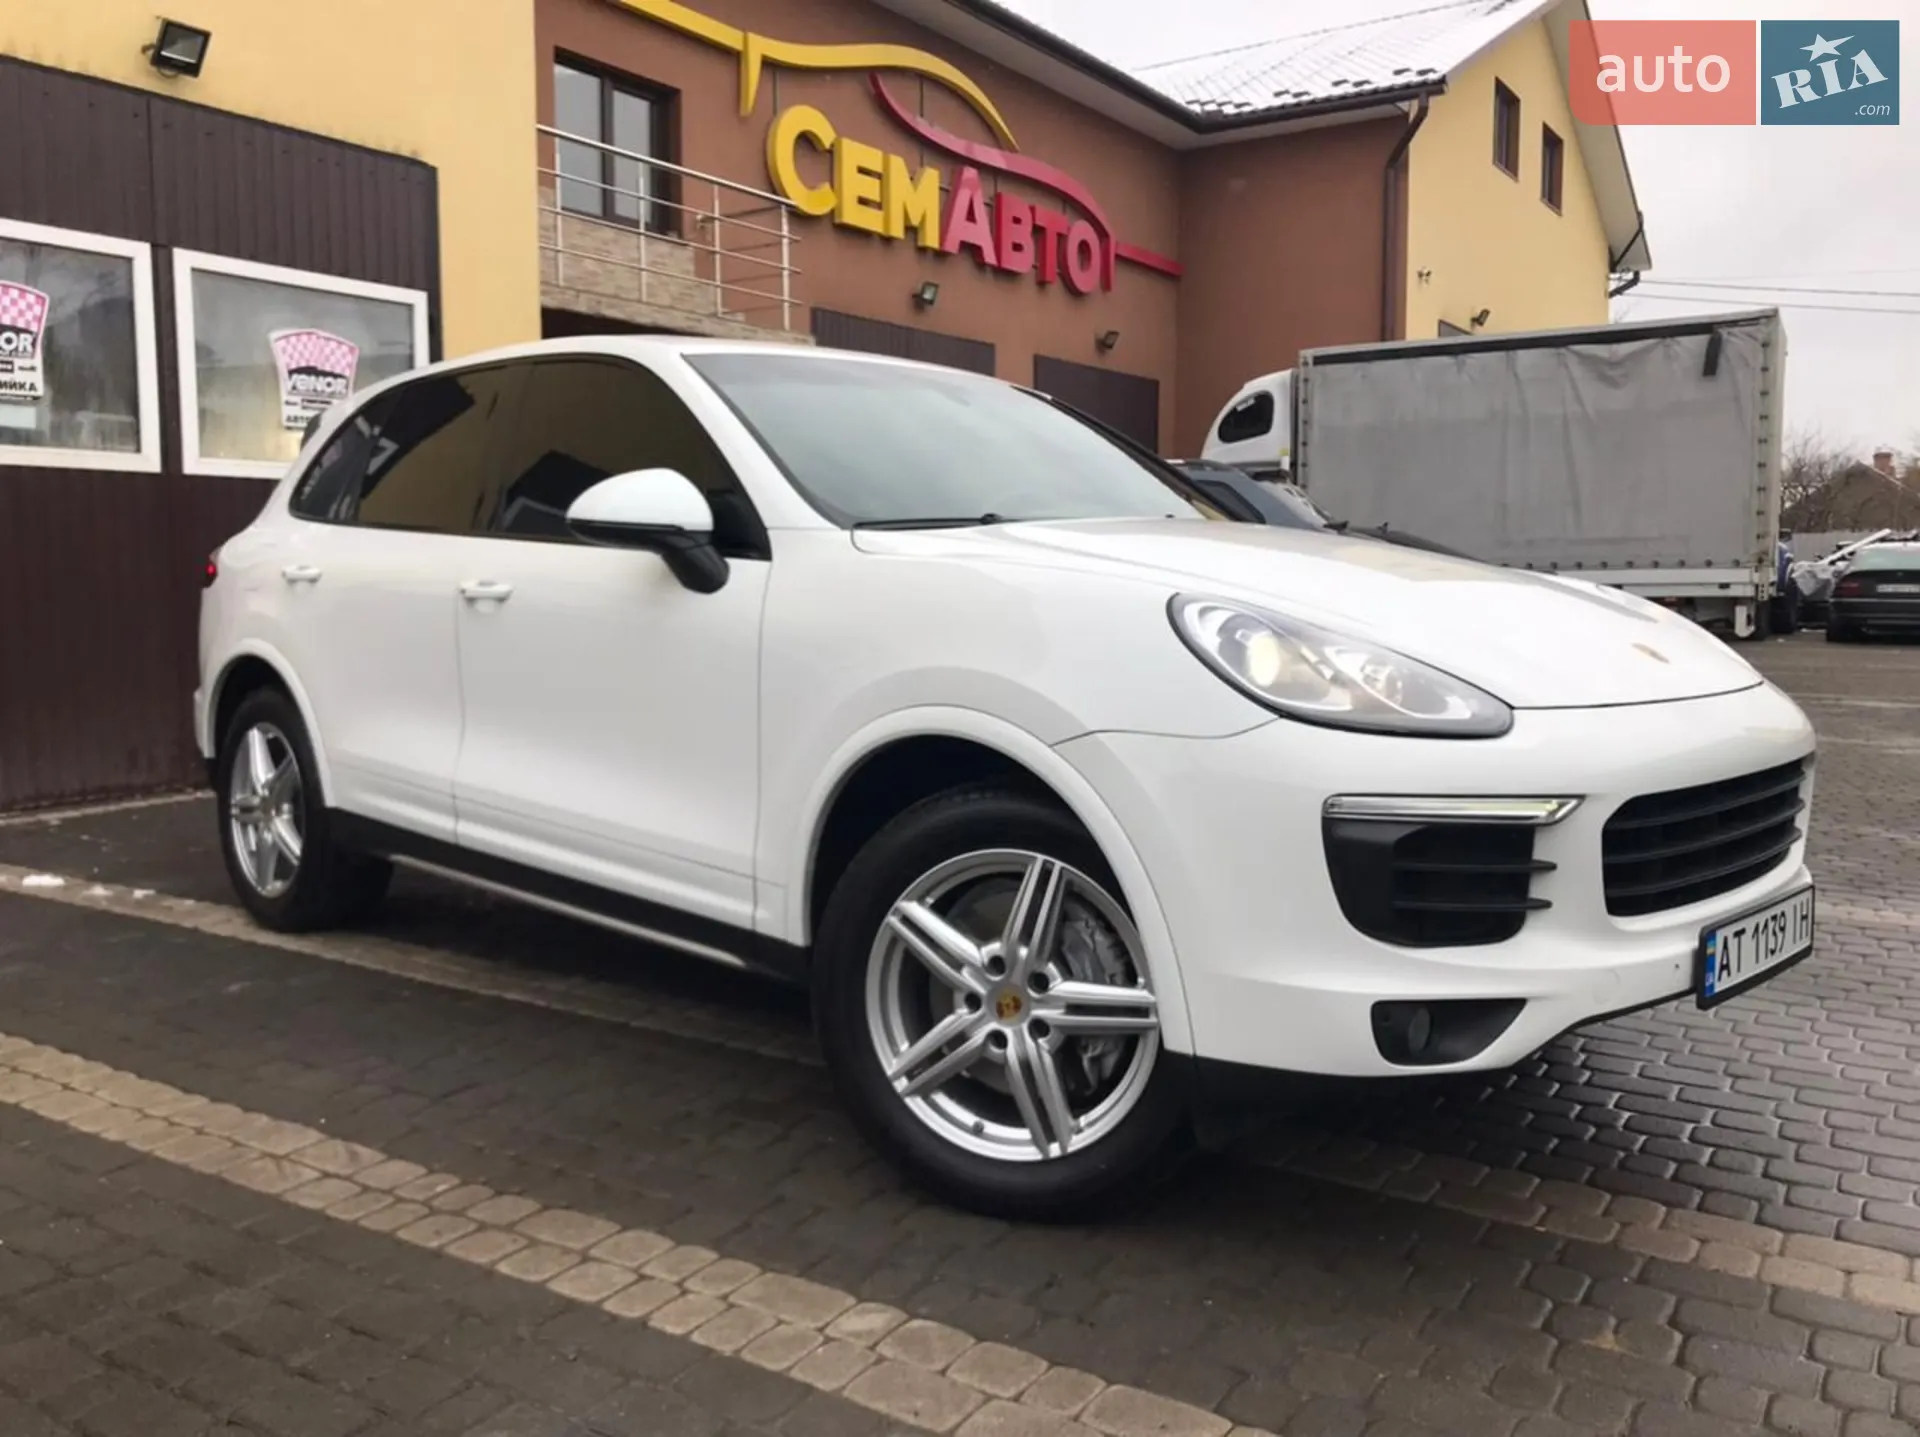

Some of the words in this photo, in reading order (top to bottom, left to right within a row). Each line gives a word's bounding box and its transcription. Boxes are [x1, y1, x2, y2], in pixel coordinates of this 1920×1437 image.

[1718, 927, 1746, 983] AT
[1752, 911, 1787, 964] 1139
[1793, 897, 1810, 945] IH
